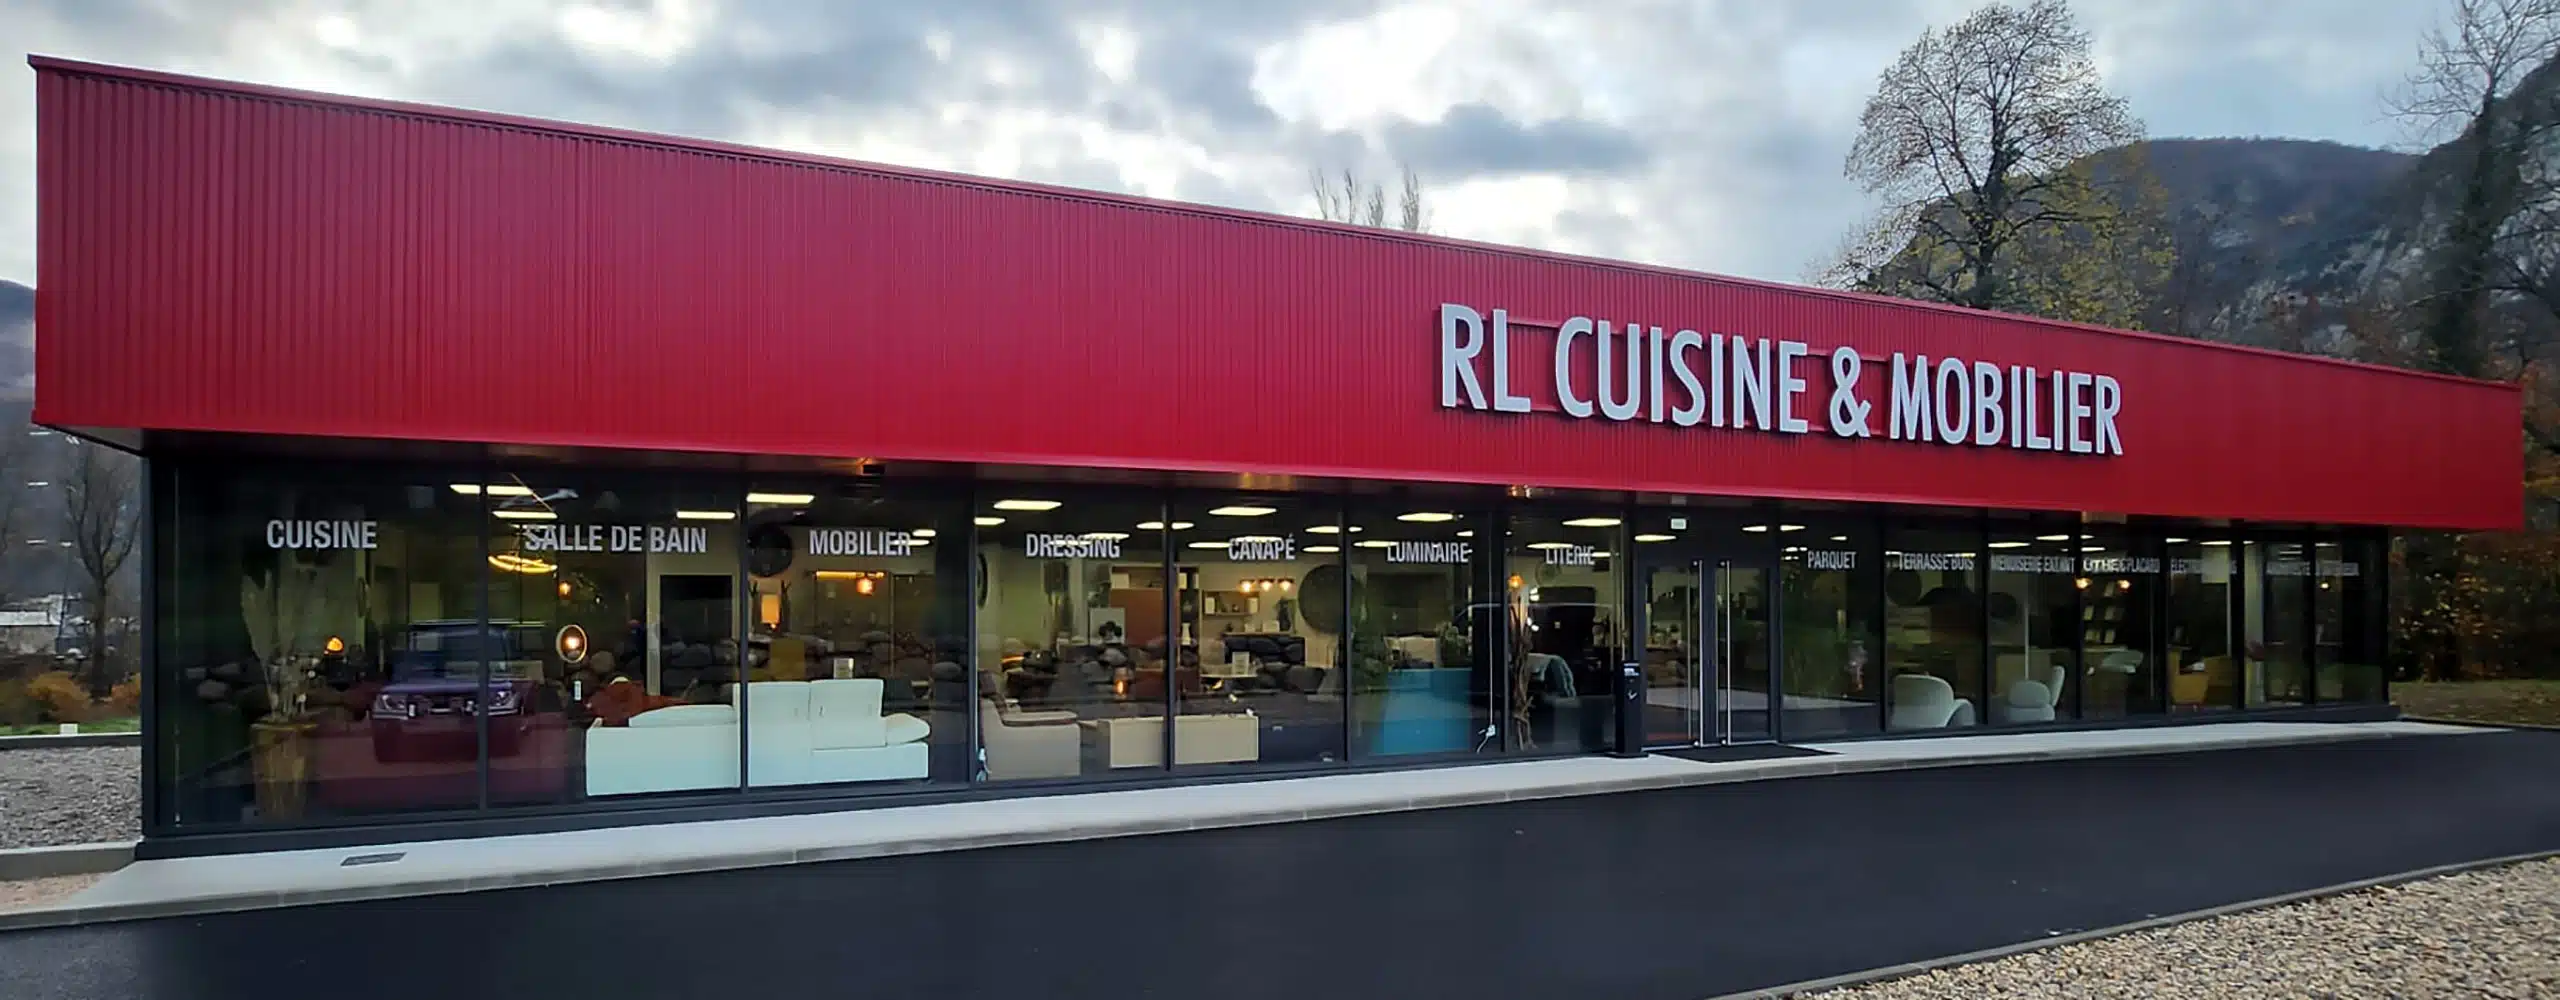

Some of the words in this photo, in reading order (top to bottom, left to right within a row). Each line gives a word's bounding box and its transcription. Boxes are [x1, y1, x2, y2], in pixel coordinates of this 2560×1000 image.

[1441, 303, 1531, 413] RL
[1555, 317, 1808, 433] CUISINE
[1829, 346, 1872, 438] &
[1890, 352, 2124, 456] MOBILIER
[266, 519, 378, 549] CUISINE
[525, 525, 603, 551] SALLE
[610, 526, 643, 553] DE
[650, 526, 707, 553] BAIN
[809, 530, 912, 556] MOBILIER
[1025, 533, 1121, 558] DRESSING
[1228, 533, 1296, 561] CANAPÉ
[1387, 541, 1469, 564] LUMINAIRE
[1545, 545, 1596, 566] LITERIE
[1807, 551, 1857, 569] PARQUET
[1898, 552, 1949, 571] TERRASSE
